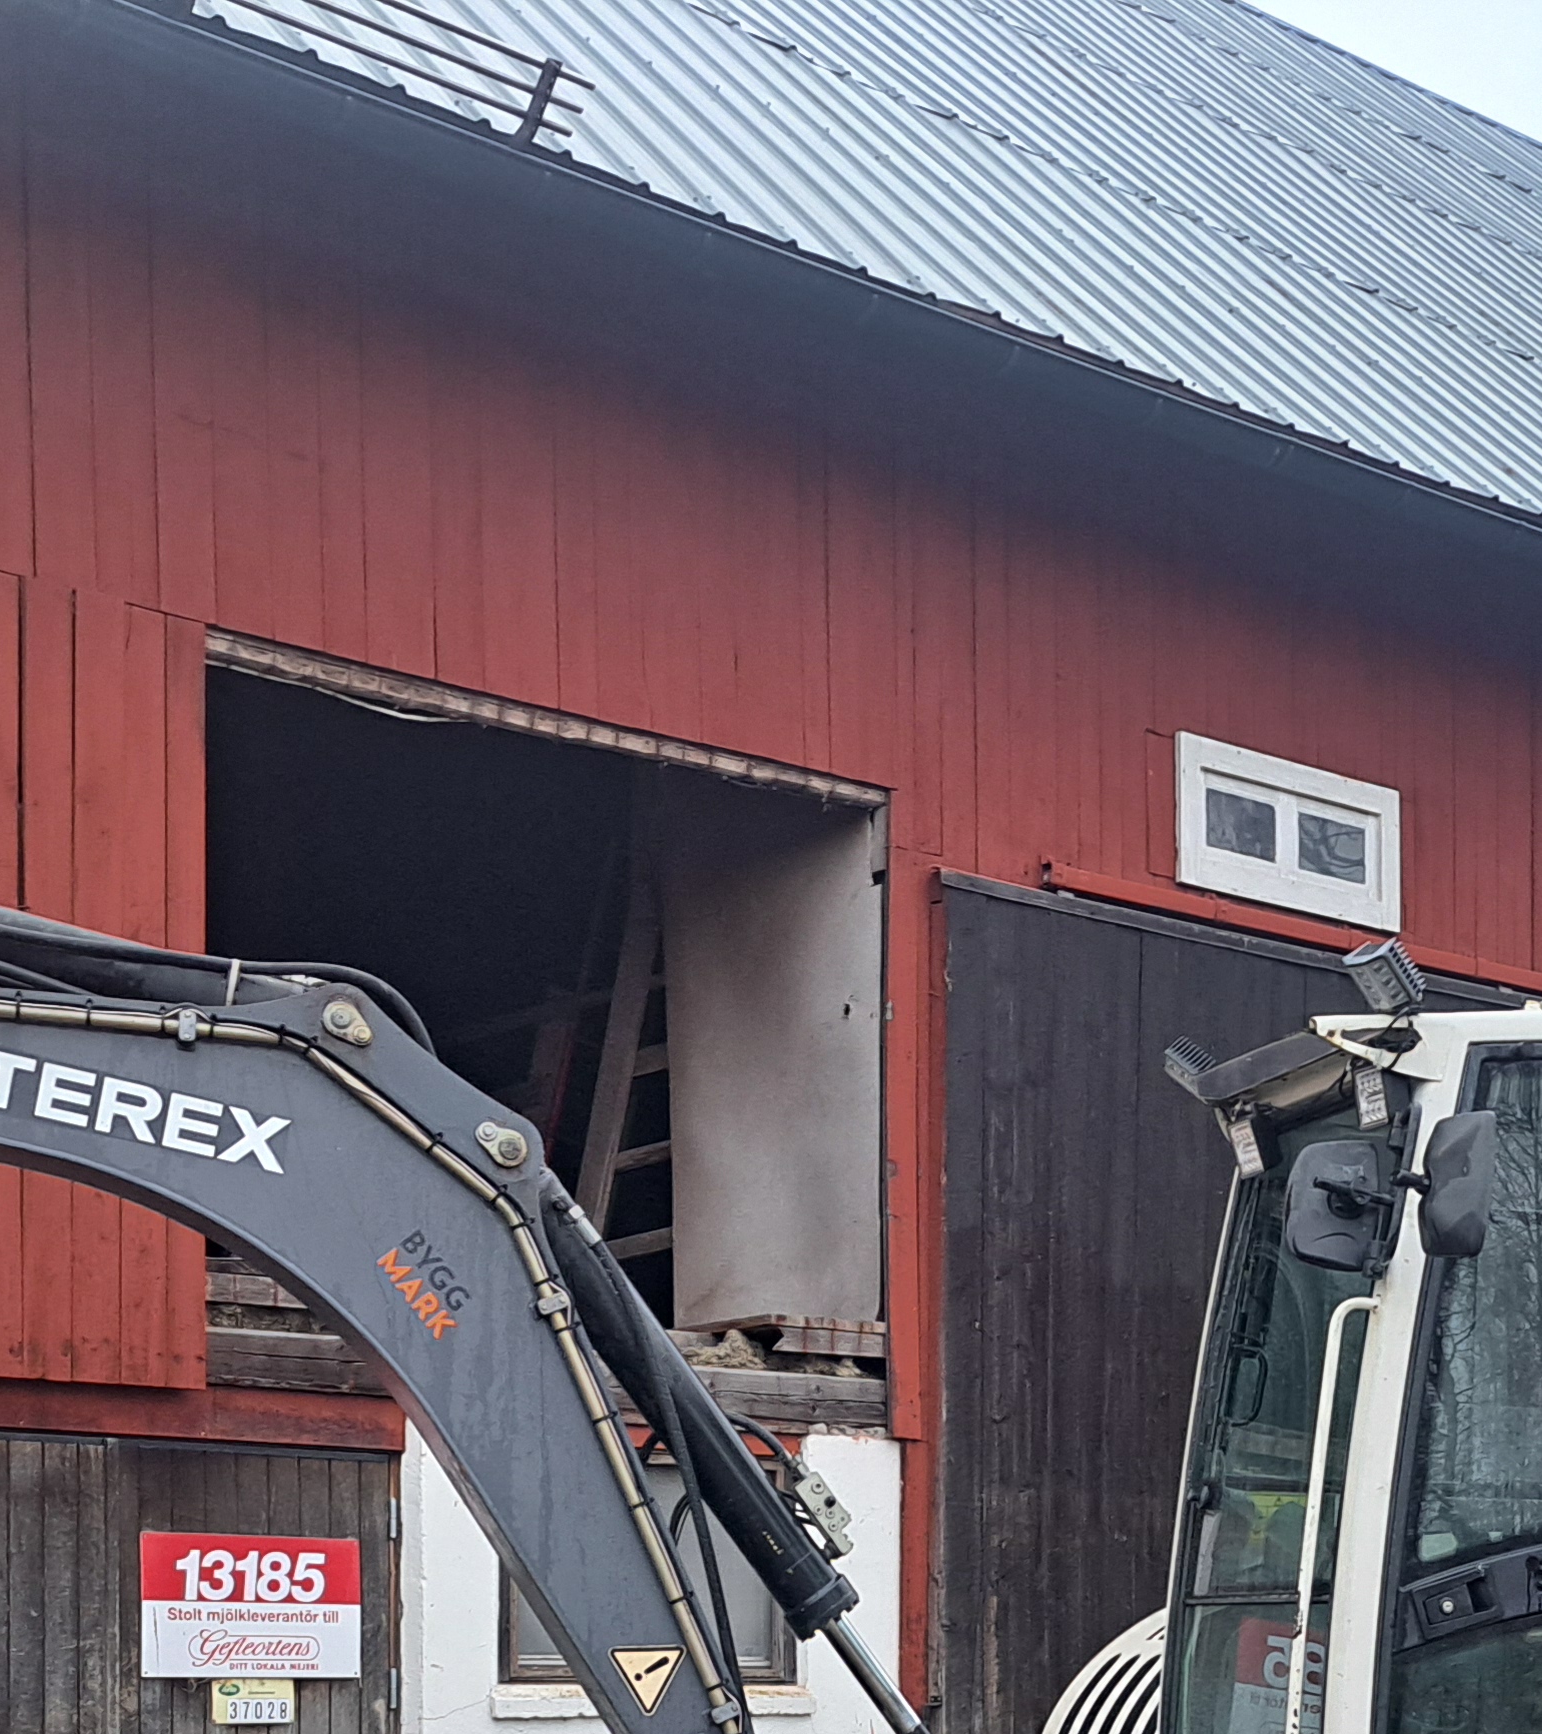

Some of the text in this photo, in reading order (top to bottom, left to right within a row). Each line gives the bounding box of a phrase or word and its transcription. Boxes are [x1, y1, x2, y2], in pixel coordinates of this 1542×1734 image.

[376, 1247, 458, 1340] MARK
[399, 1229, 471, 1312] BYGG
[174, 1549, 327, 1603] 13185
[167, 1606, 340, 1624] Stolt mjölkleverantör till
[229, 1701, 288, 1720] 37028
